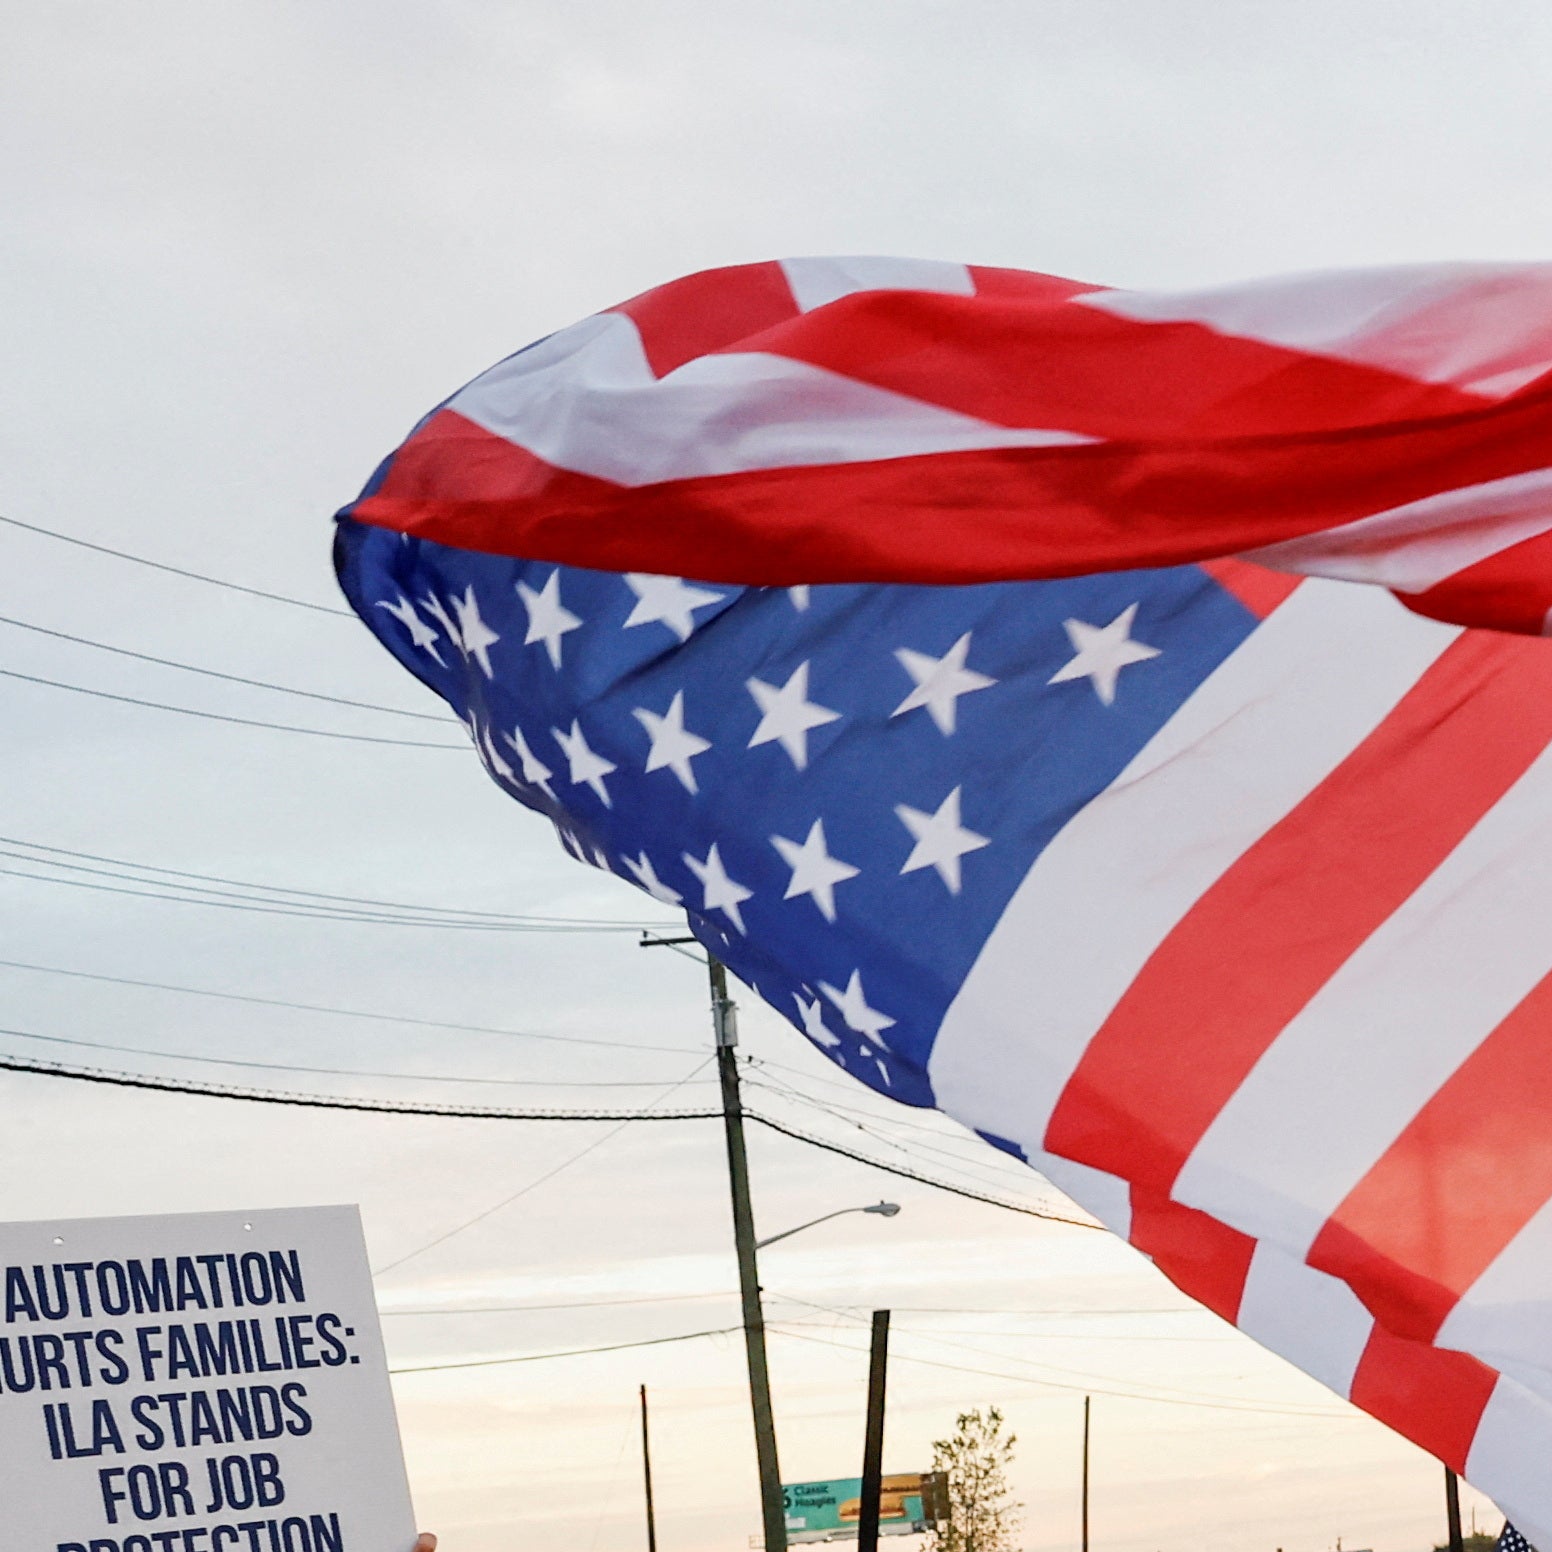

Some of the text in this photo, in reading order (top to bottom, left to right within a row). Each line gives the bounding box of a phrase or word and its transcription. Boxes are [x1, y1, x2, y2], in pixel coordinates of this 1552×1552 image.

[6, 1250, 305, 1323] AUTOMATION
[0, 1313, 360, 1394] URTS FAMILIES:
[43, 1383, 312, 1459] ILA STANDS
[99, 1453, 285, 1524] FOR JOB
